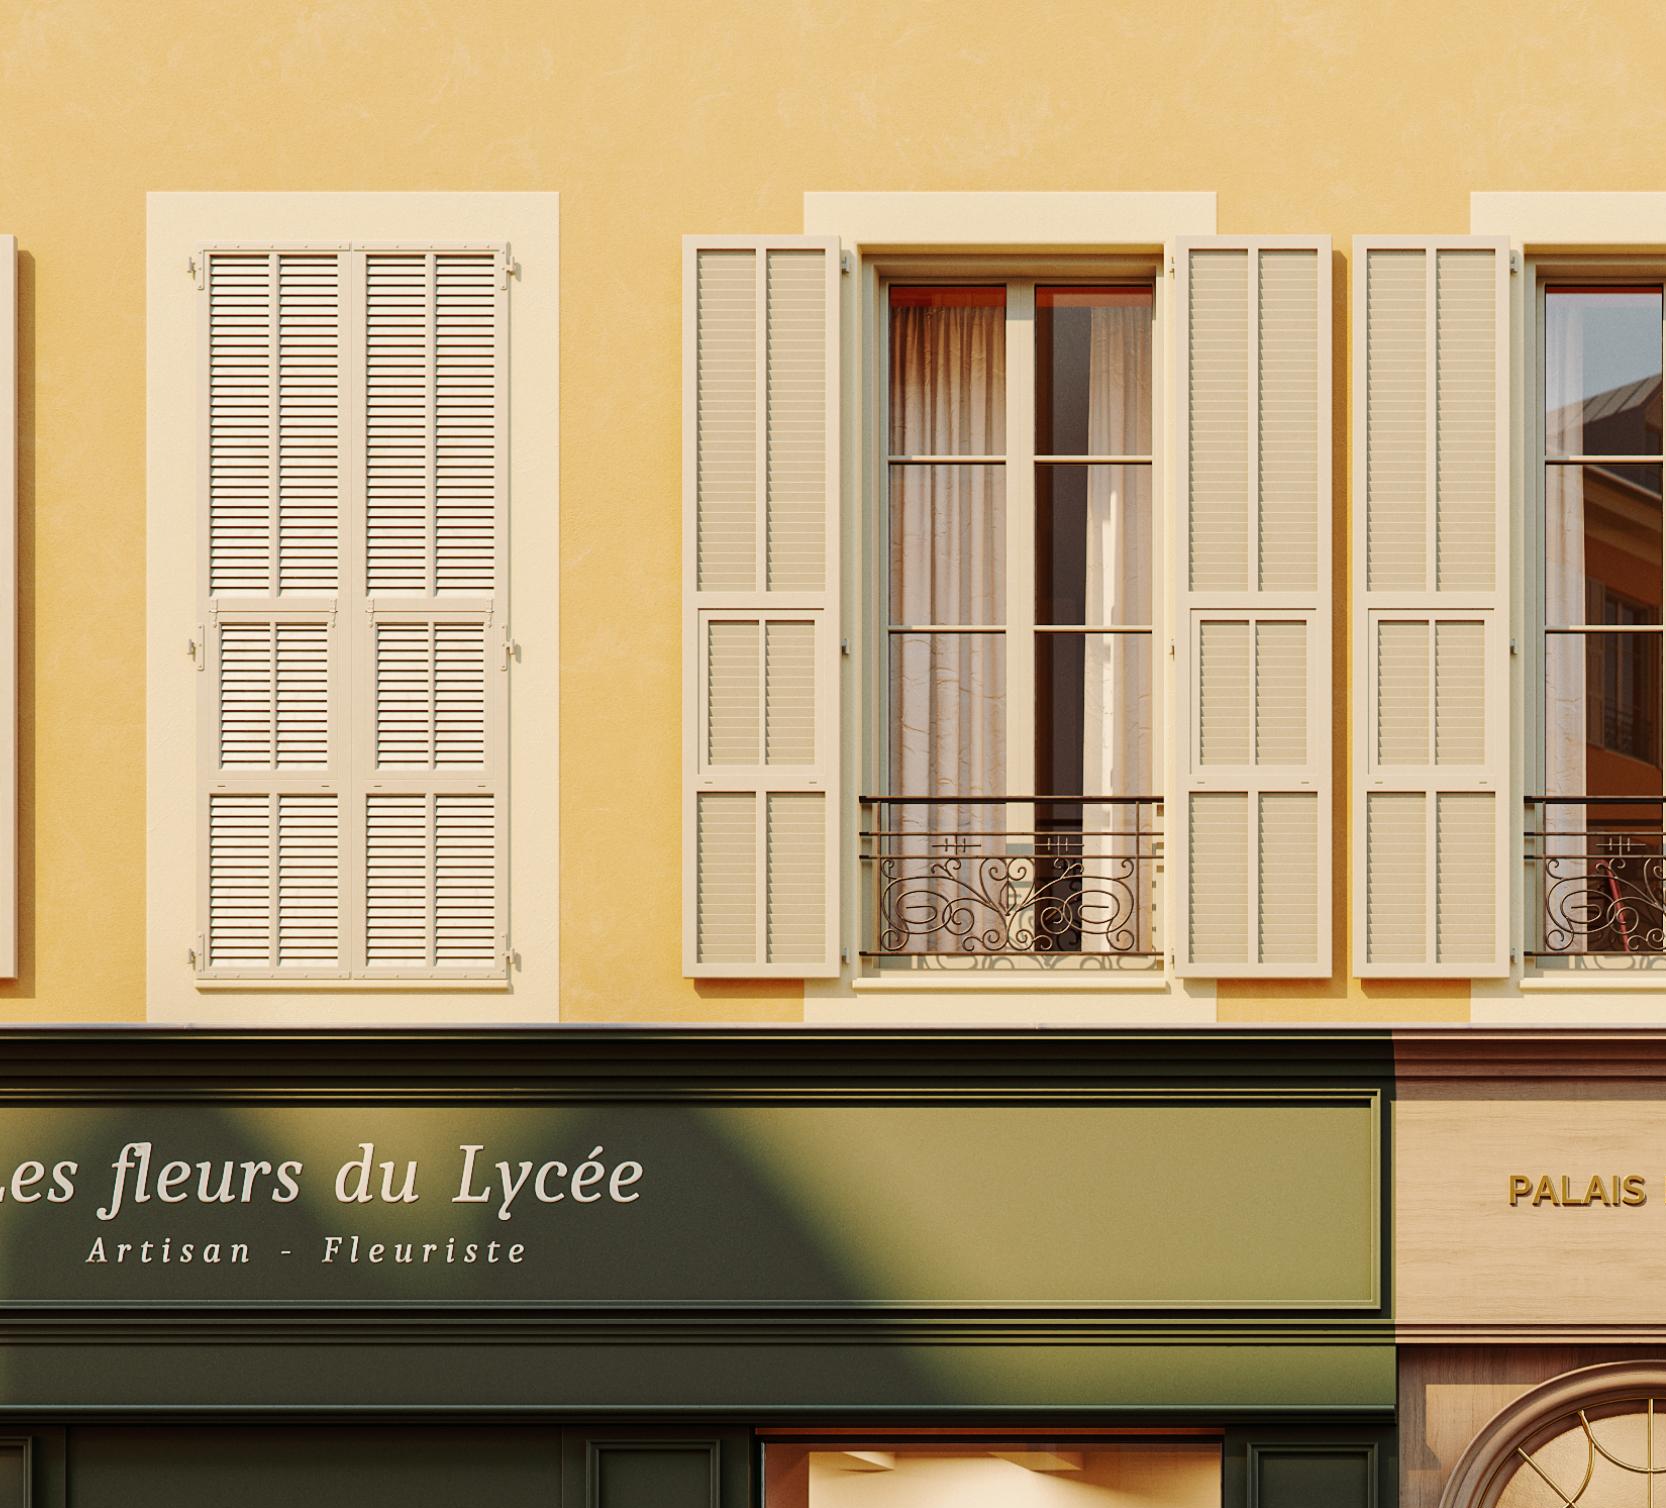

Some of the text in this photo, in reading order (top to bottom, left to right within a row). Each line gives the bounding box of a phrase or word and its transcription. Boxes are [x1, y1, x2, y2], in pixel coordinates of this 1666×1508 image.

[0, 1141, 644, 1221] es fleurs du Lycée
[1508, 1175, 1647, 1207] PALAIS
[84, 1235, 251, 1263] Artisan
[321, 1235, 527, 1264] Fleuriste
